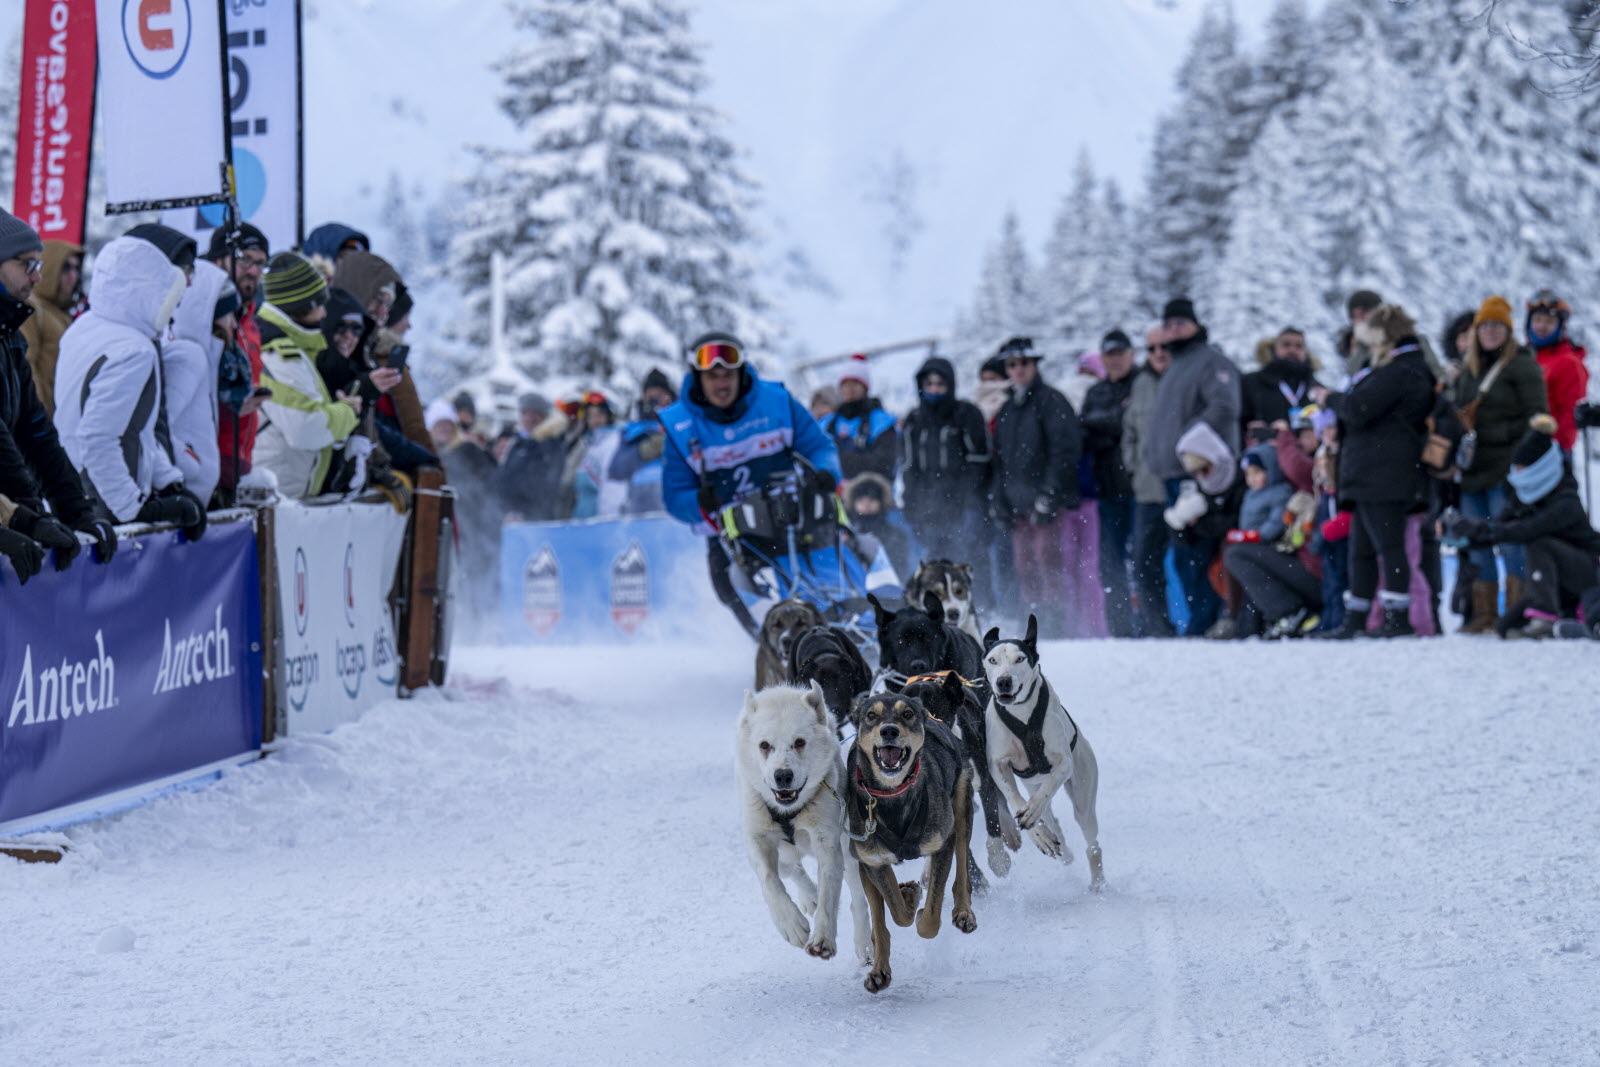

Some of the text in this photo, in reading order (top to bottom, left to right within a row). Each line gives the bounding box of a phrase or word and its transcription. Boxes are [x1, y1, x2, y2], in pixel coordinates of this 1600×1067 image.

[733, 465, 754, 493] 2
[7, 629, 115, 728] Antech
[153, 603, 230, 695] Antech
